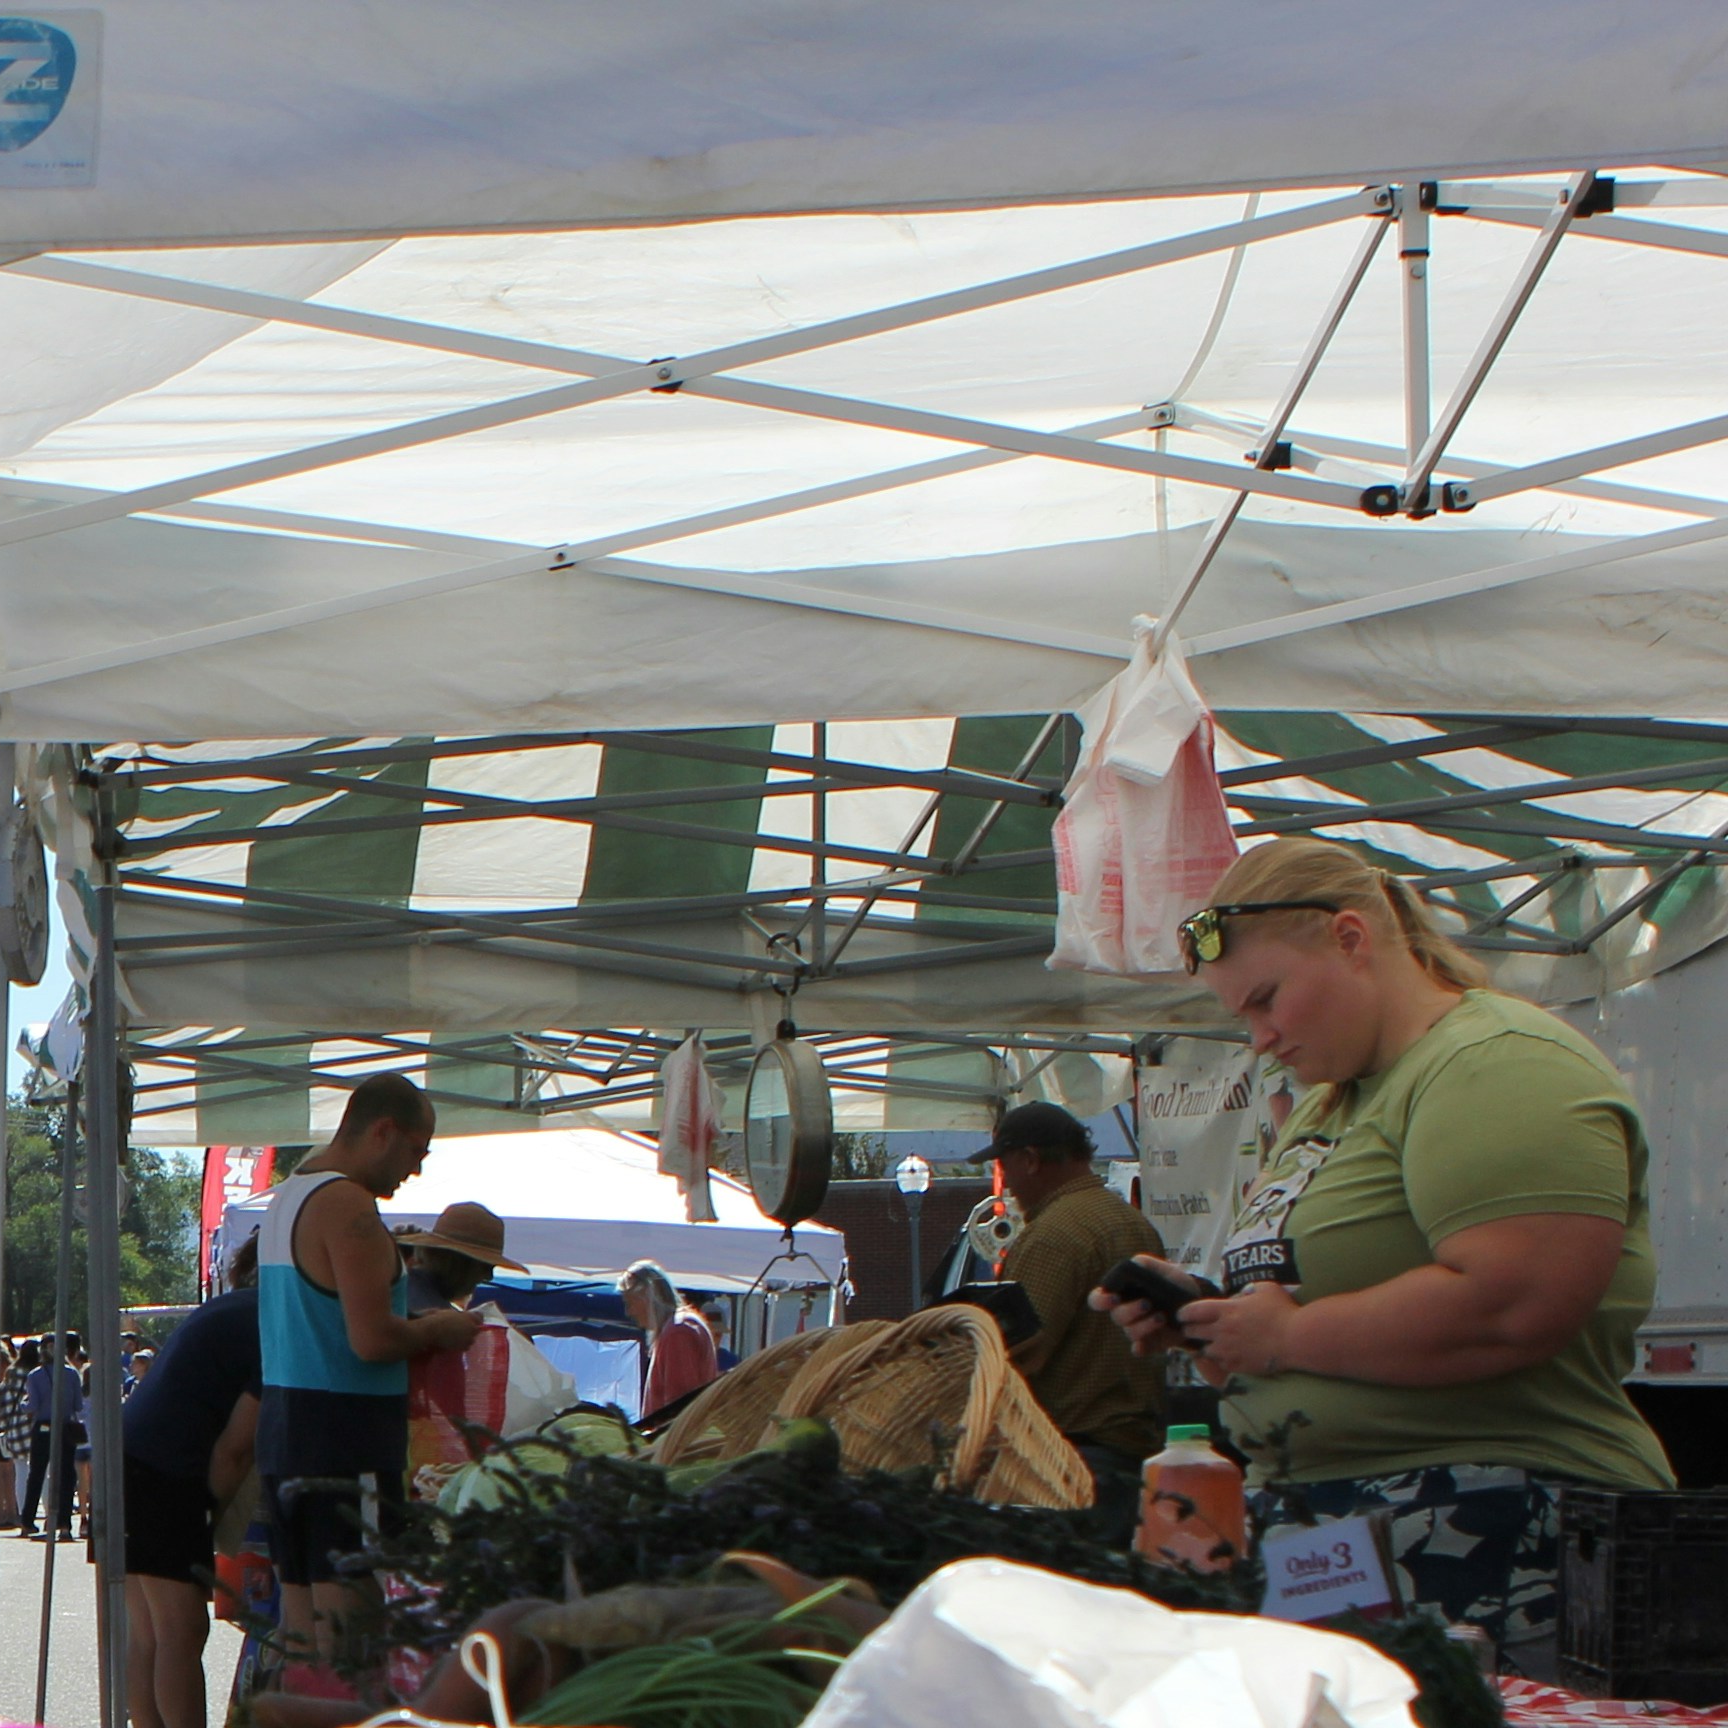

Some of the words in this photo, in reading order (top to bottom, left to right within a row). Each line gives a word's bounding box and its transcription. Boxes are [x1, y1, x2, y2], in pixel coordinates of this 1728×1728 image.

[1228, 1246, 1285, 1272] YEARS
[1286, 1550, 1331, 1576] Only
[1332, 1541, 1353, 1570] 3
